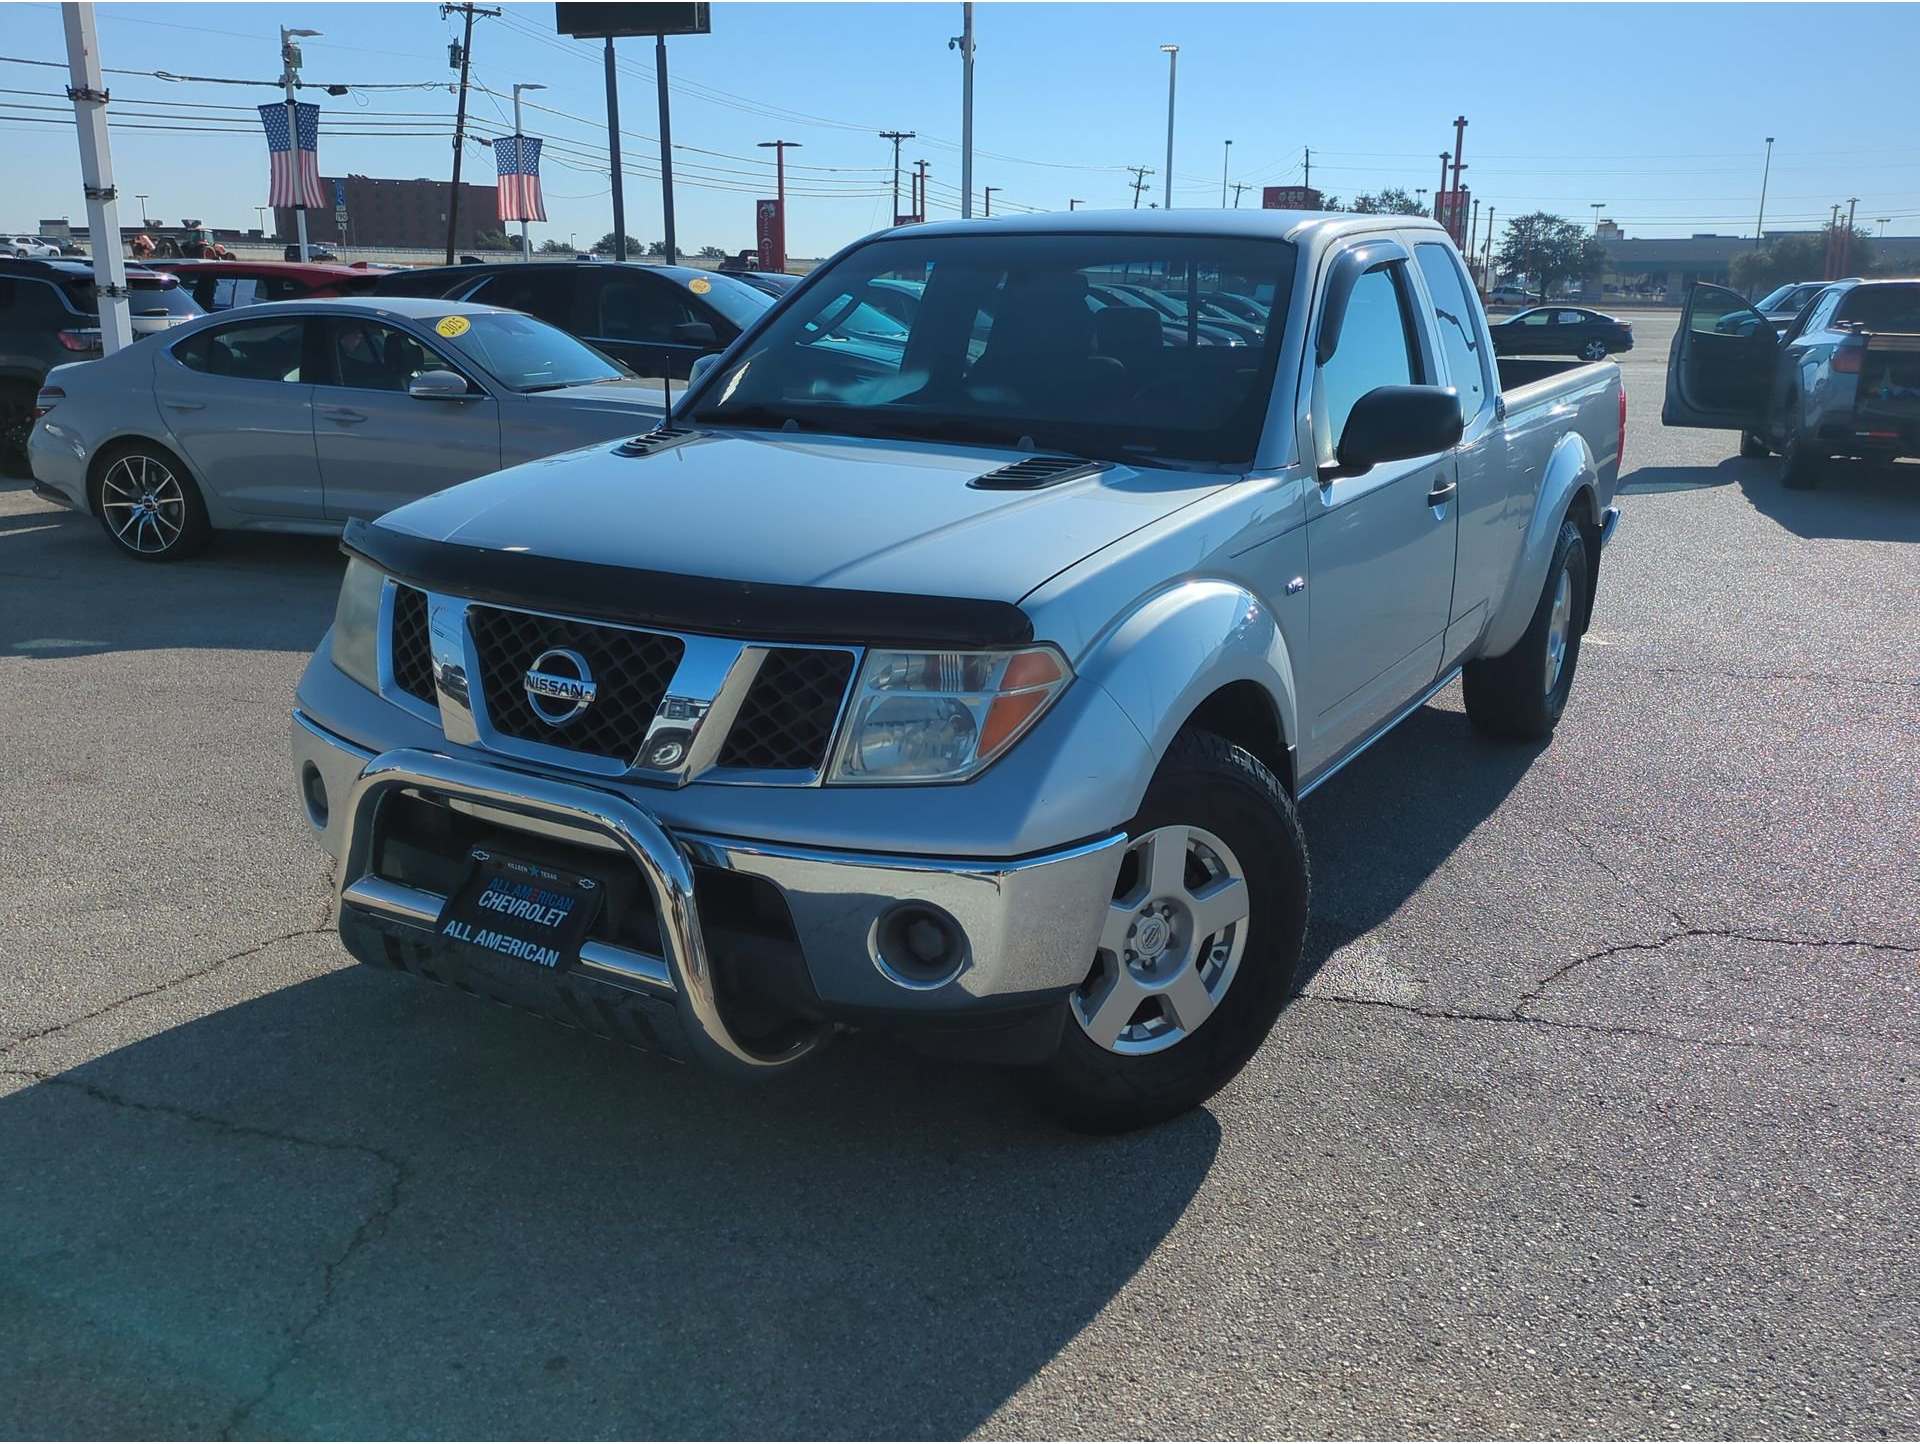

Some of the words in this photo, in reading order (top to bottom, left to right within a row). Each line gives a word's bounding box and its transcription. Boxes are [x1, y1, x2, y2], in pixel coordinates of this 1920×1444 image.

[525, 676, 584, 698] NISSAN
[477, 890, 569, 928] CHEVROLET
[489, 878, 509, 892] ALL
[512, 883, 575, 910] AMERICAN
[442, 919, 472, 942] ALL
[473, 929, 560, 968] AMERICAN
